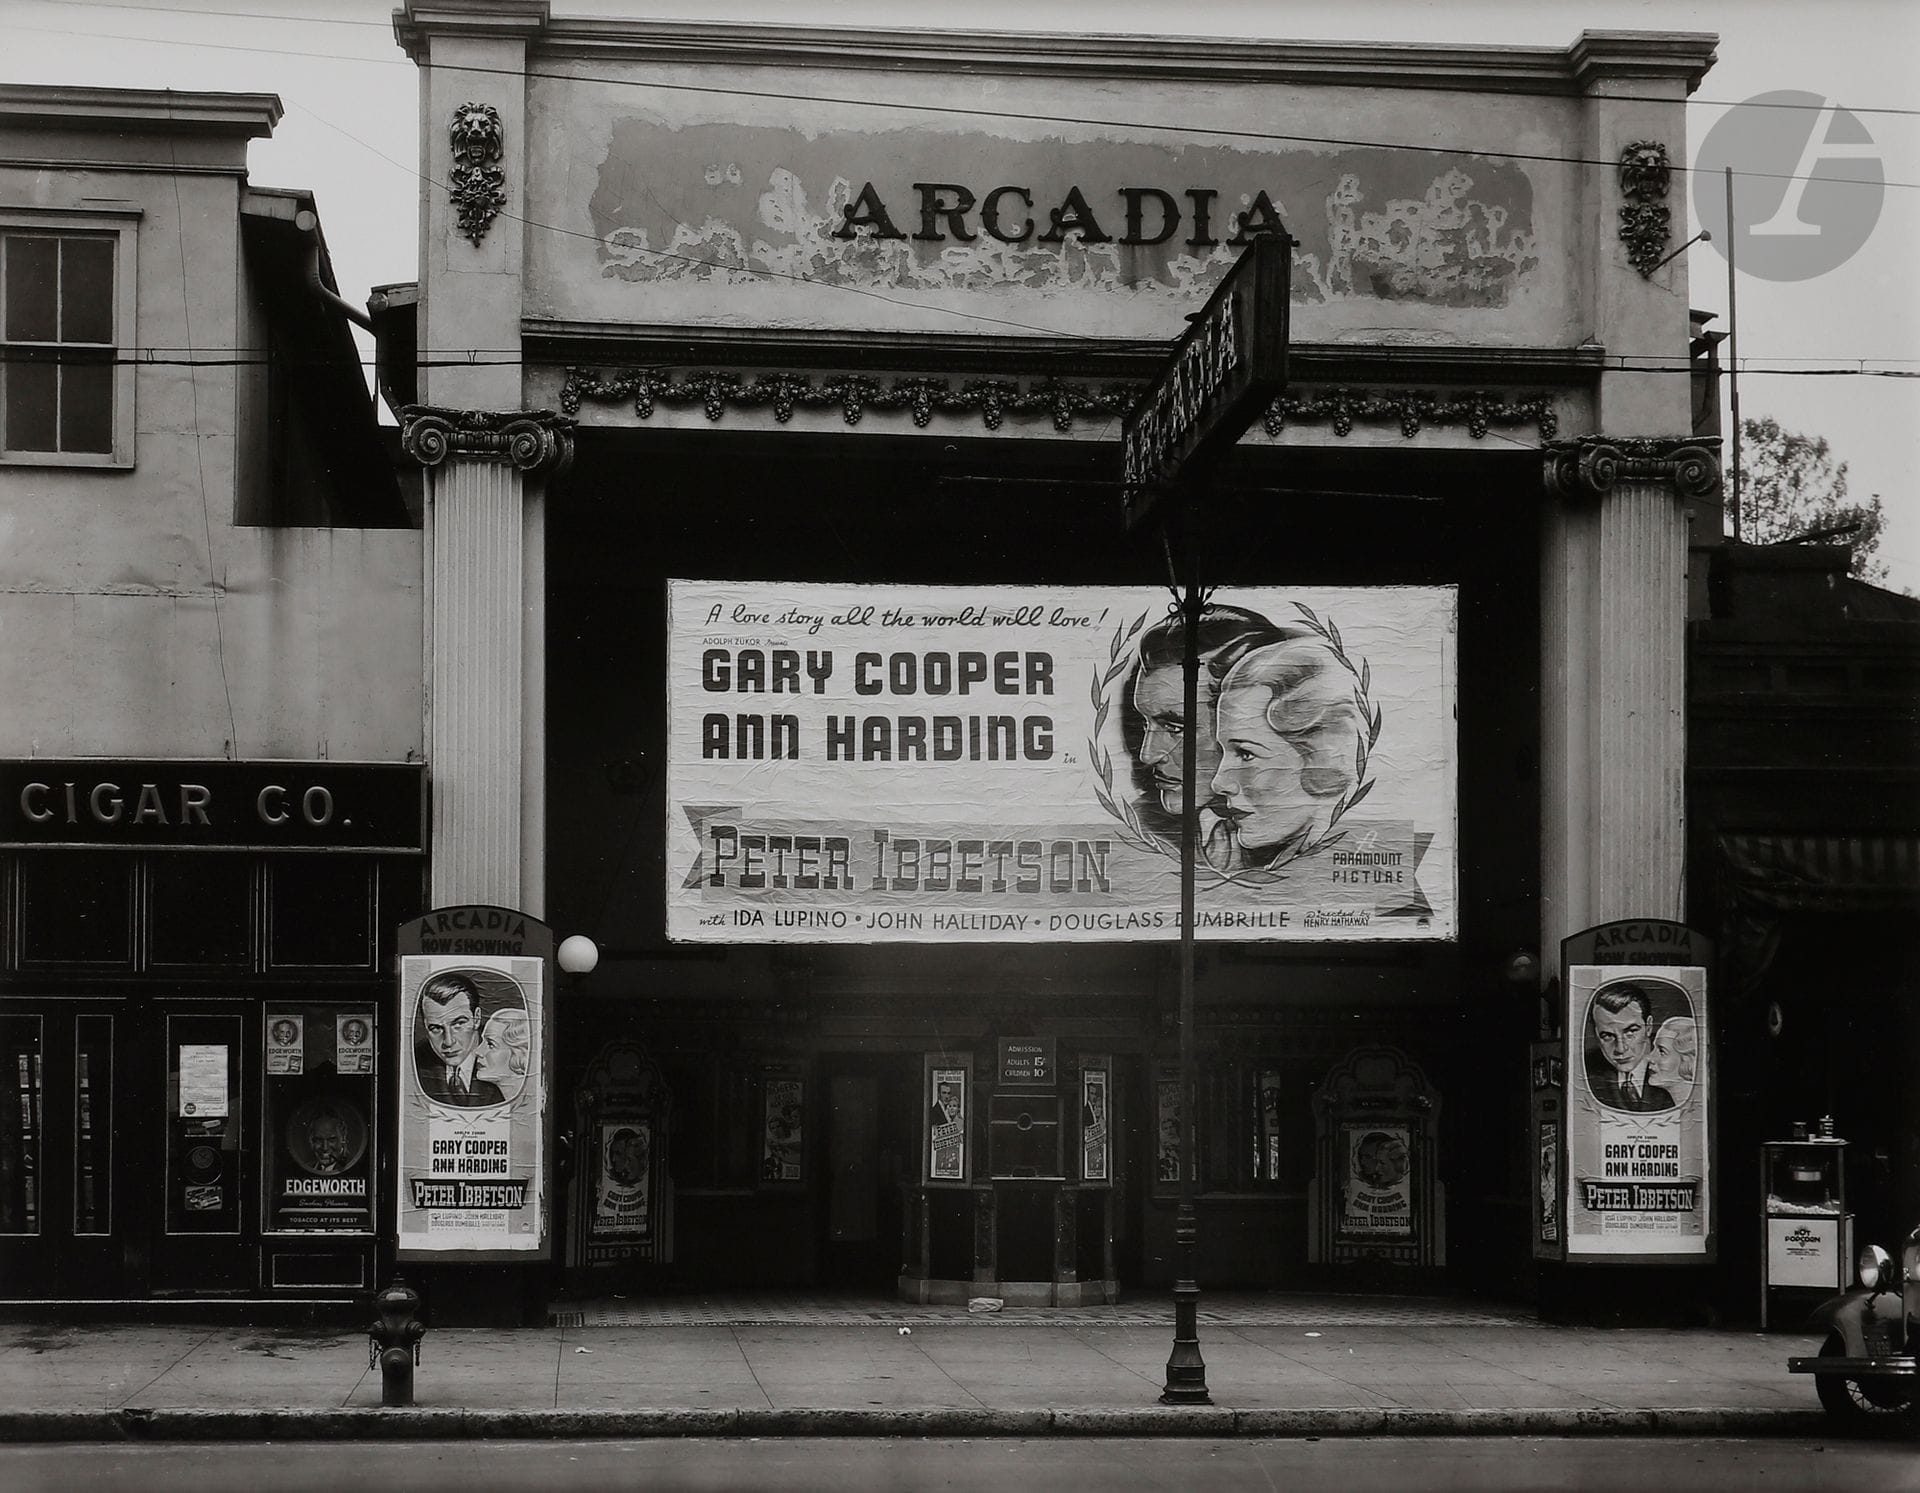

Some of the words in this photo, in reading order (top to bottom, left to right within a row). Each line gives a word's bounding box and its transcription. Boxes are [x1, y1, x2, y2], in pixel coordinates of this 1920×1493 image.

[831, 181, 1300, 247] ARCADIA
[704, 603, 722, 625] A
[730, 605, 770, 624] love
[774, 609, 823, 634] story
[831, 606, 872, 626] all
[882, 606, 916, 627] the
[922, 606, 986, 627] world
[993, 606, 1042, 627] will
[703, 637, 733, 646] ADOLPH
[735, 638, 761, 647] ZUKOR
[703, 648, 833, 694] GARY
[855, 651, 1055, 696] COOPER
[703, 713, 799, 760] ANN
[827, 716, 1054, 762] HARDING
[1063, 753, 1077, 765] in
[20, 782, 212, 826] CIGAR
[257, 784, 352, 826] CO.
[710, 825, 855, 890] PETER
[872, 829, 1112, 893] IBBETSON
[1332, 852, 1403, 866] PARAMOUNT
[1332, 870, 1403, 883] PICTURE
[420, 910, 526, 939] ARCADIA
[700, 913, 726, 927] with
[733, 910, 765, 927] IDA
[775, 910, 848, 928] LUPINO
[867, 911, 923, 930] JOHN
[933, 913, 1029, 931] HALLIDAY
[1050, 911, 1163, 931] DOUGLASS
[1303, 917, 1329, 928] HENRY
[1331, 917, 1369, 927] HATHAWAY
[1594, 924, 1691, 951] ARCADIA
[421, 938, 452, 953] NOW
[454, 938, 523, 954] SHOWING
[433, 1140, 462, 1155] GARY
[465, 1140, 508, 1155] COOPER
[1605, 1144, 1635, 1159] GARY
[1638, 1144, 1678, 1159] COOPER
[433, 1158, 455, 1173] ANN
[458, 1158, 507, 1174] HARDING
[1605, 1162, 1628, 1177] ANN
[1631, 1162, 1678, 1177] HARDING
[286, 1178, 366, 1194] EDGEWORTH
[415, 1181, 456, 1207] PETER
[459, 1181, 523, 1208] IBBETSON
[1586, 1184, 1631, 1209] PETER
[1633, 1184, 1694, 1209] IBBETSON
[1794, 1229, 1811, 1237] HOT
